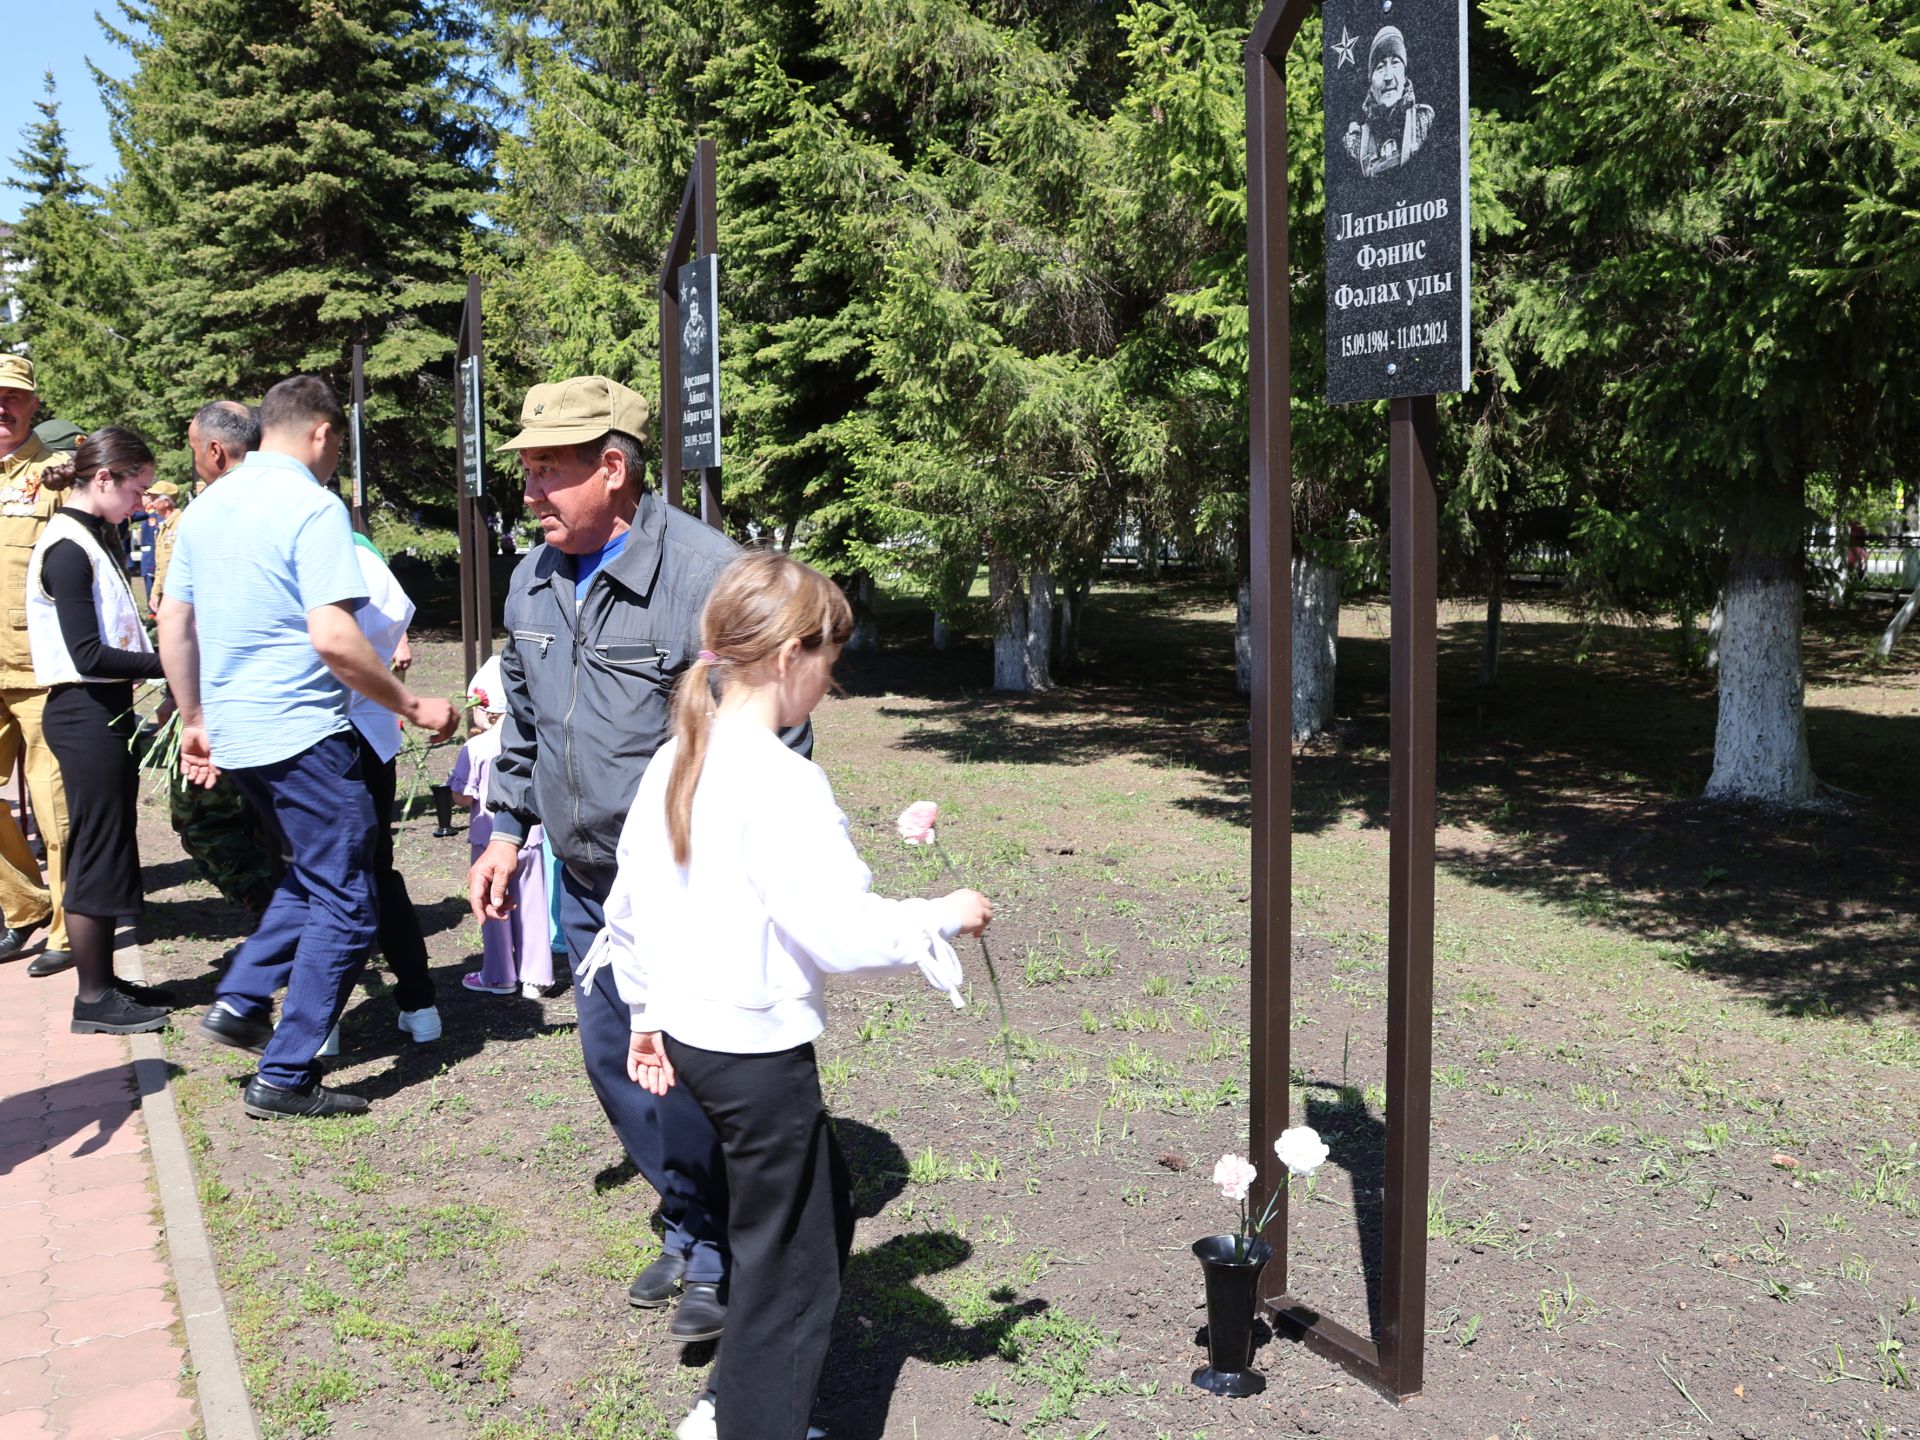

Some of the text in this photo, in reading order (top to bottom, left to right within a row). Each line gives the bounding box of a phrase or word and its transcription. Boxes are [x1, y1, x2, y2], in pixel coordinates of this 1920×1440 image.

[1336, 198, 1449, 241] Латыйпов
[1356, 239, 1427, 271] Фәнис
[1334, 271, 1453, 310] Фәлах улы
[1341, 329, 1389, 357] 15.09.1984
[1397, 320, 1448, 350] 11.03.2024
